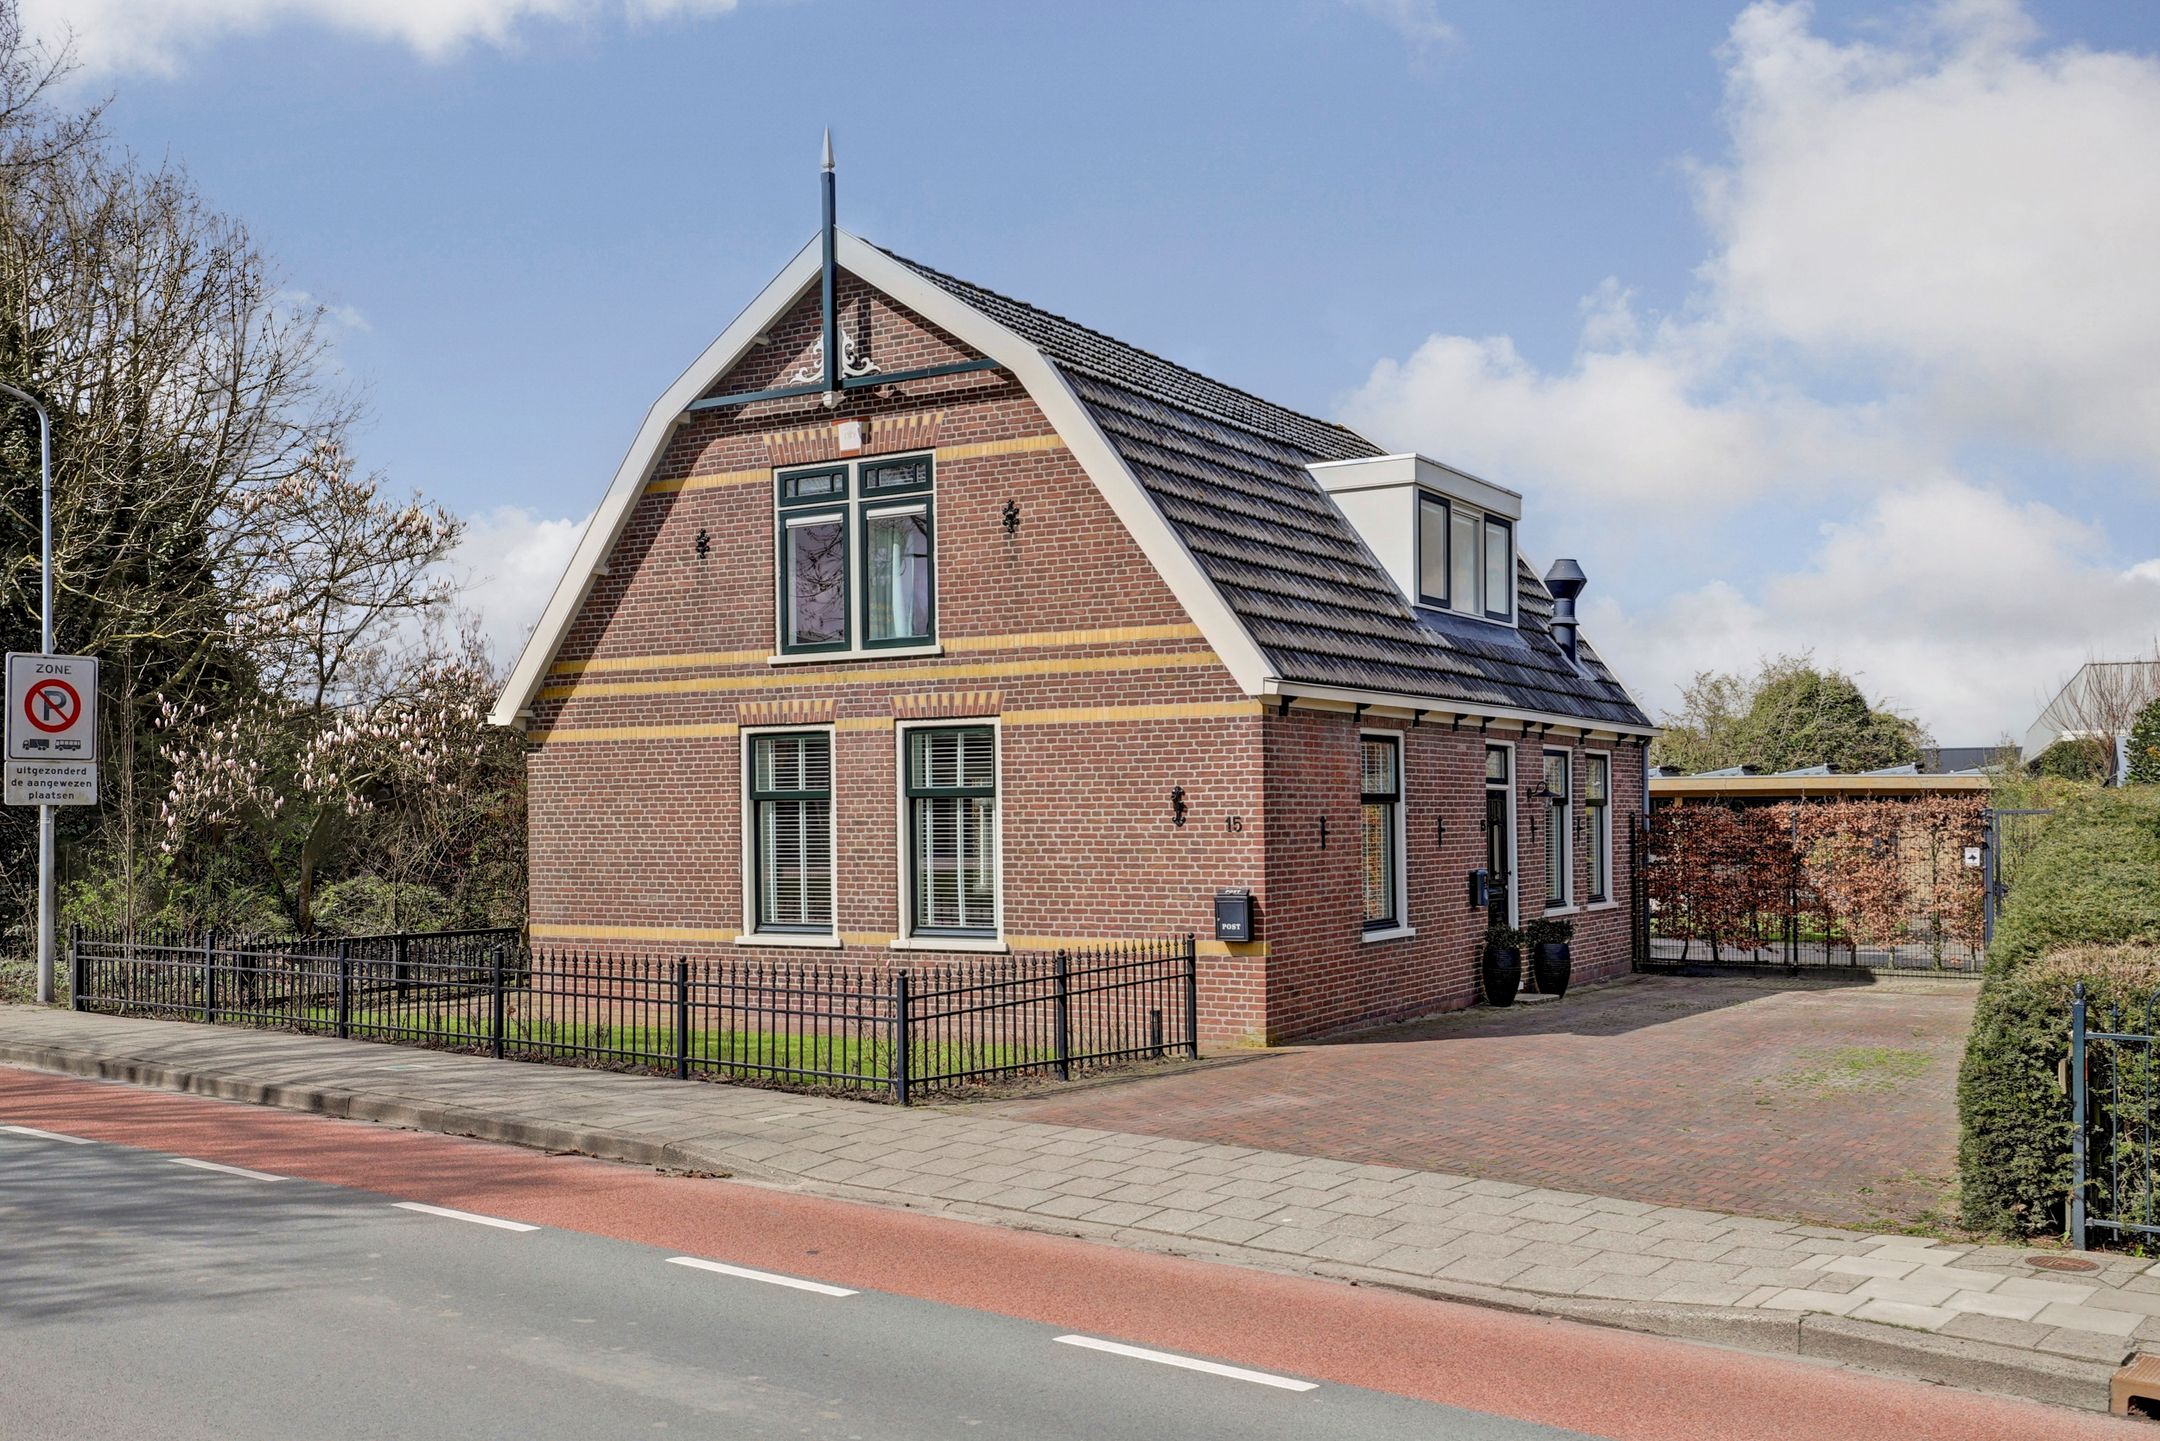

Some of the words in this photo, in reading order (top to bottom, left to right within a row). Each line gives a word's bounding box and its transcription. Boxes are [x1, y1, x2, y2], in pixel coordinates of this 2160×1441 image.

[35, 663, 72, 675] ZONE
[43, 690, 67, 721] P
[16, 766, 88, 776] uitgezonderd
[11, 779, 23, 787] de
[27, 779, 92, 789] aangewezen
[28, 791, 75, 800] plaatsen
[1225, 816, 1242, 833] 15
